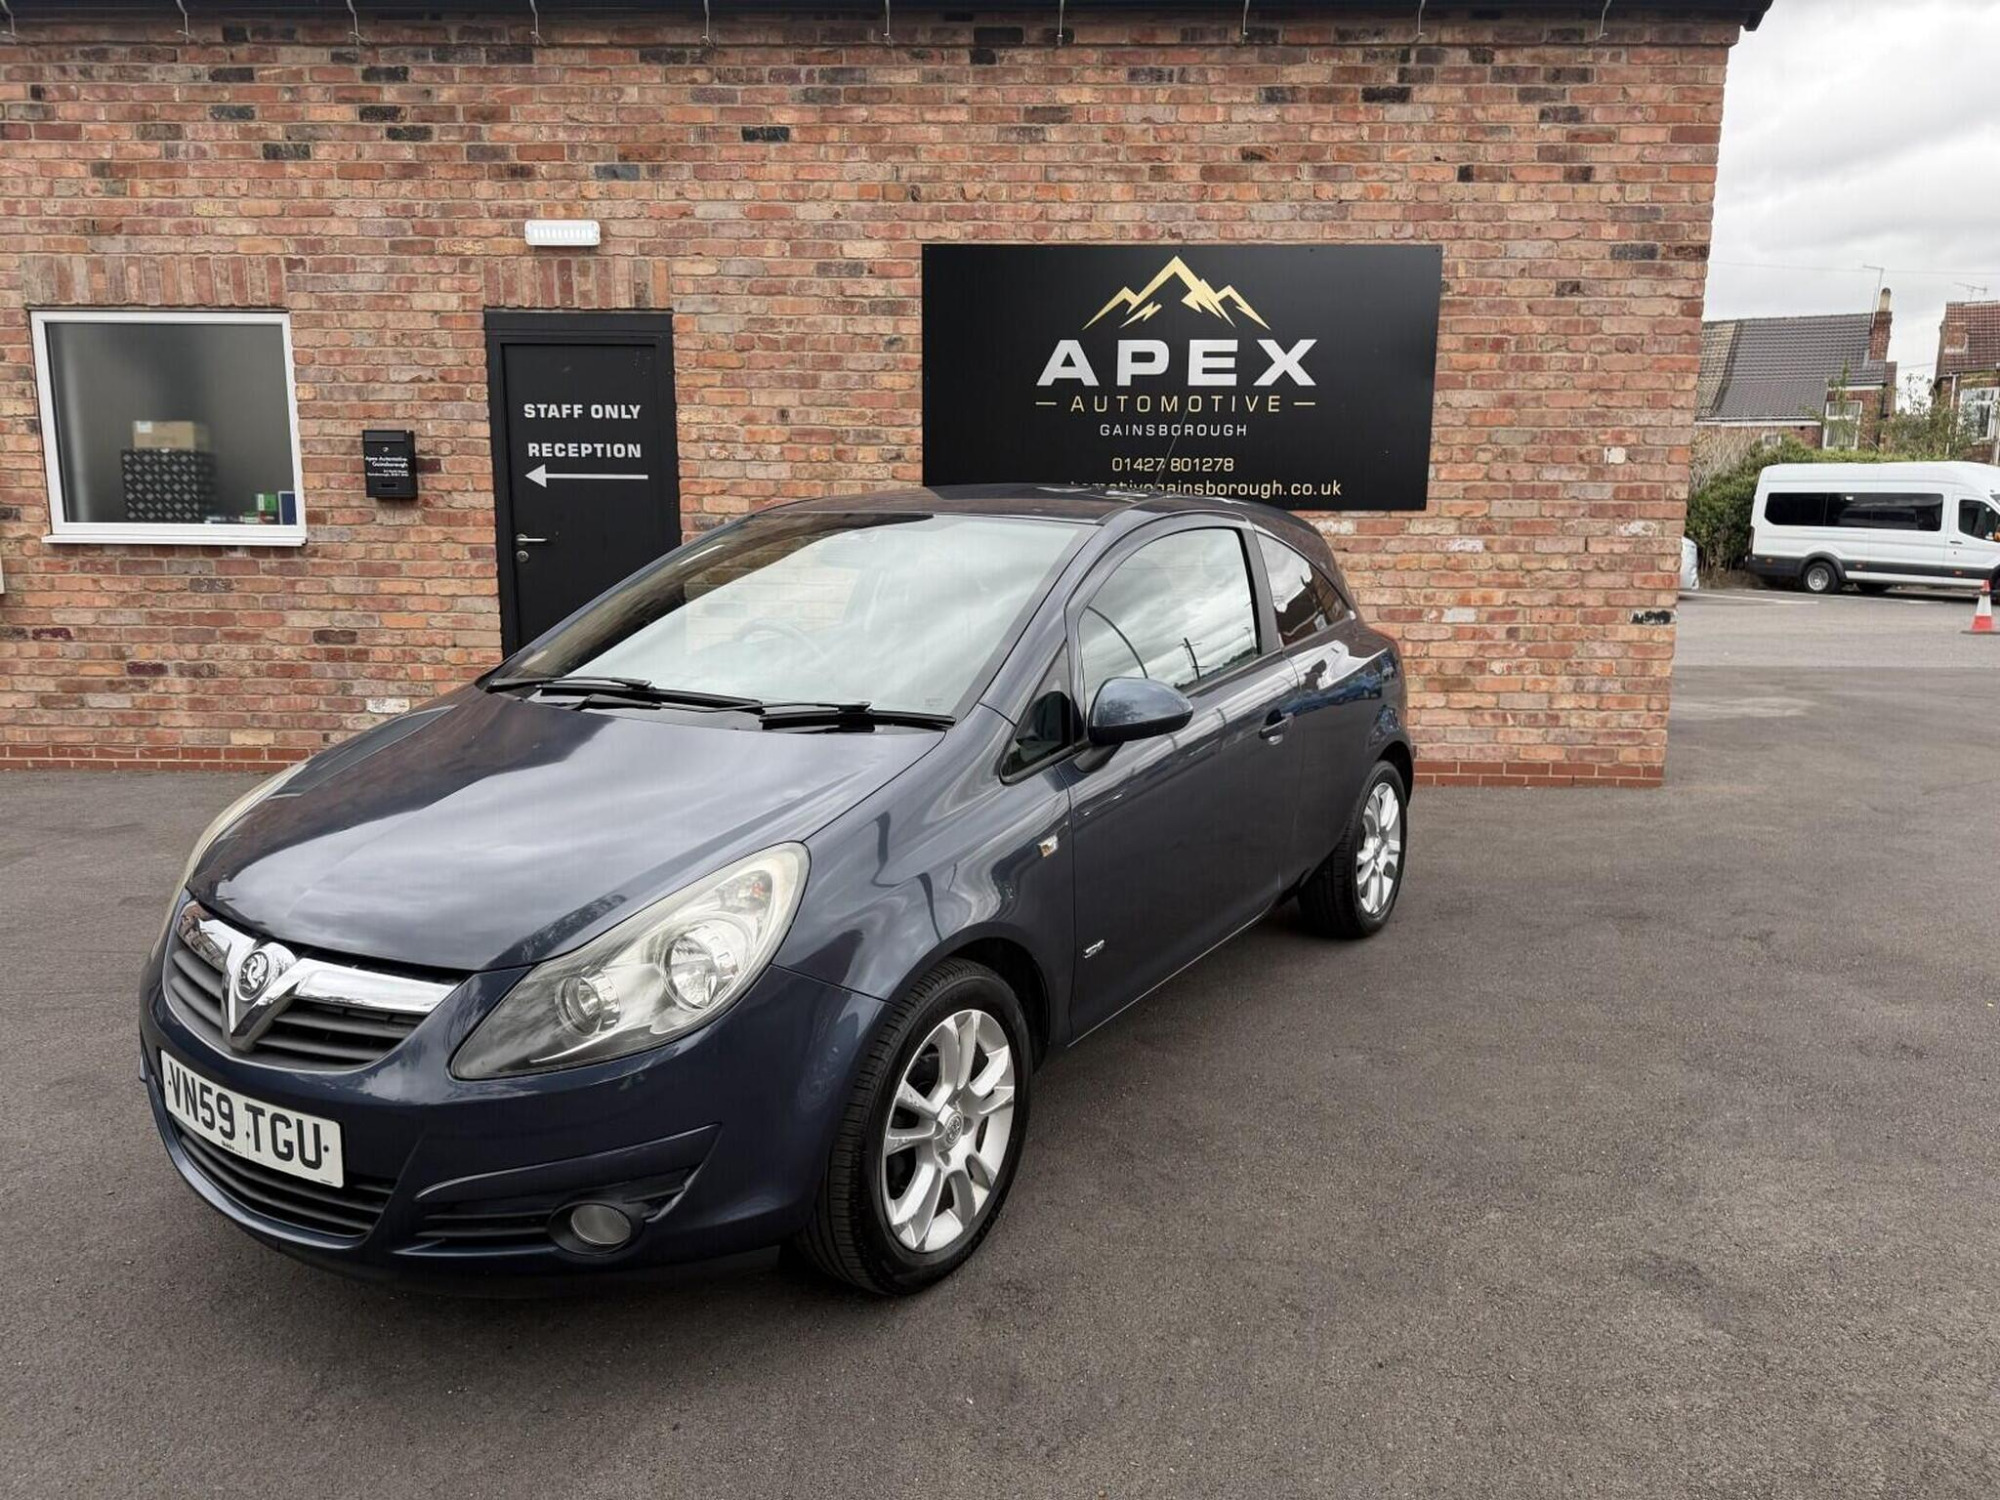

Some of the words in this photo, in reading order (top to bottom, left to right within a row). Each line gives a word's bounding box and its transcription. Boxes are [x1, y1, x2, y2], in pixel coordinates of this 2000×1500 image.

[1036, 338, 1318, 387] APEX
[523, 403, 584, 419] STAFF
[590, 404, 641, 419] ONLY
[1070, 395, 1281, 413] AUTOMOTIVE
[1099, 424, 1248, 437] GAINSBOROUGH
[527, 442, 642, 459] RECEPTION
[1111, 457, 1165, 473] 01427
[1170, 457, 1235, 473] 801278
[168, 1060, 236, 1141] VN59
[244, 1102, 322, 1171] TGU
